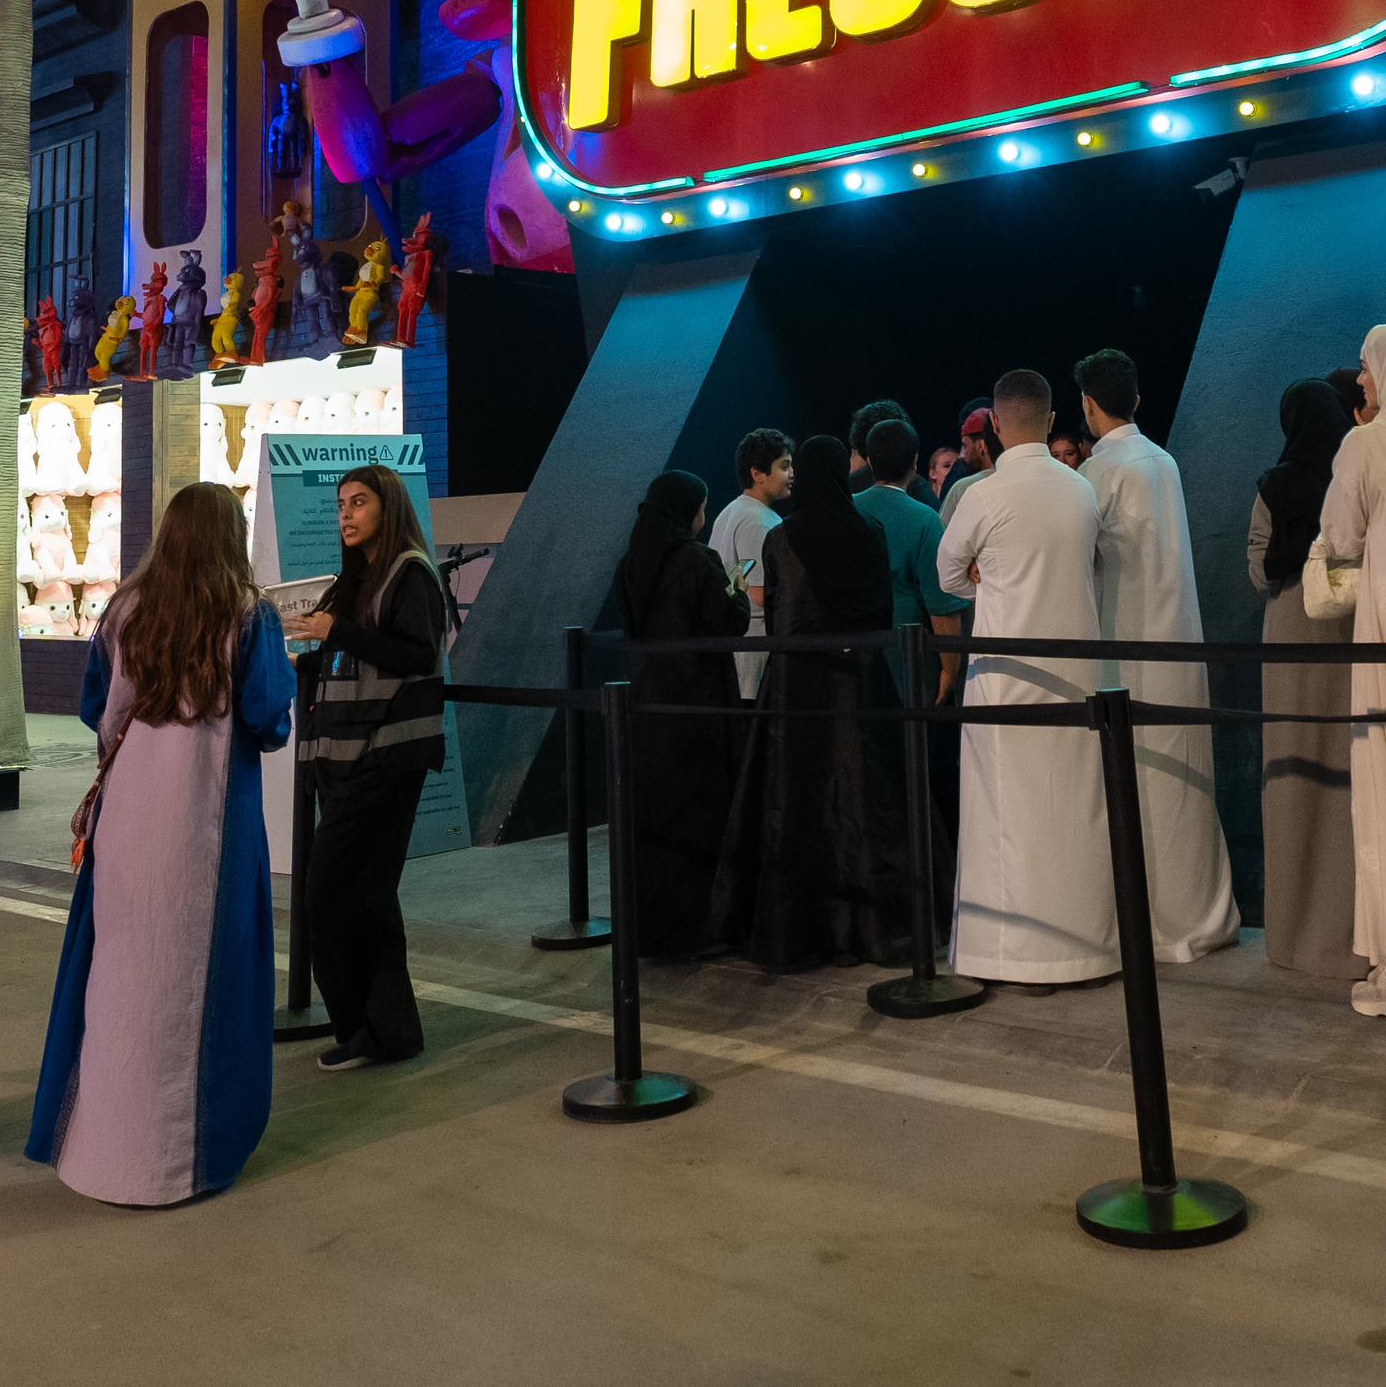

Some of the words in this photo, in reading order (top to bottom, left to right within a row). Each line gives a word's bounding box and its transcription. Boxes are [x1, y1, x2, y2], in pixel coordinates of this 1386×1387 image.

[301, 443, 379, 464] warning
[317, 473, 345, 483] INST
[277, 600, 298, 613] ast
[299, 598, 318, 610] Tra
